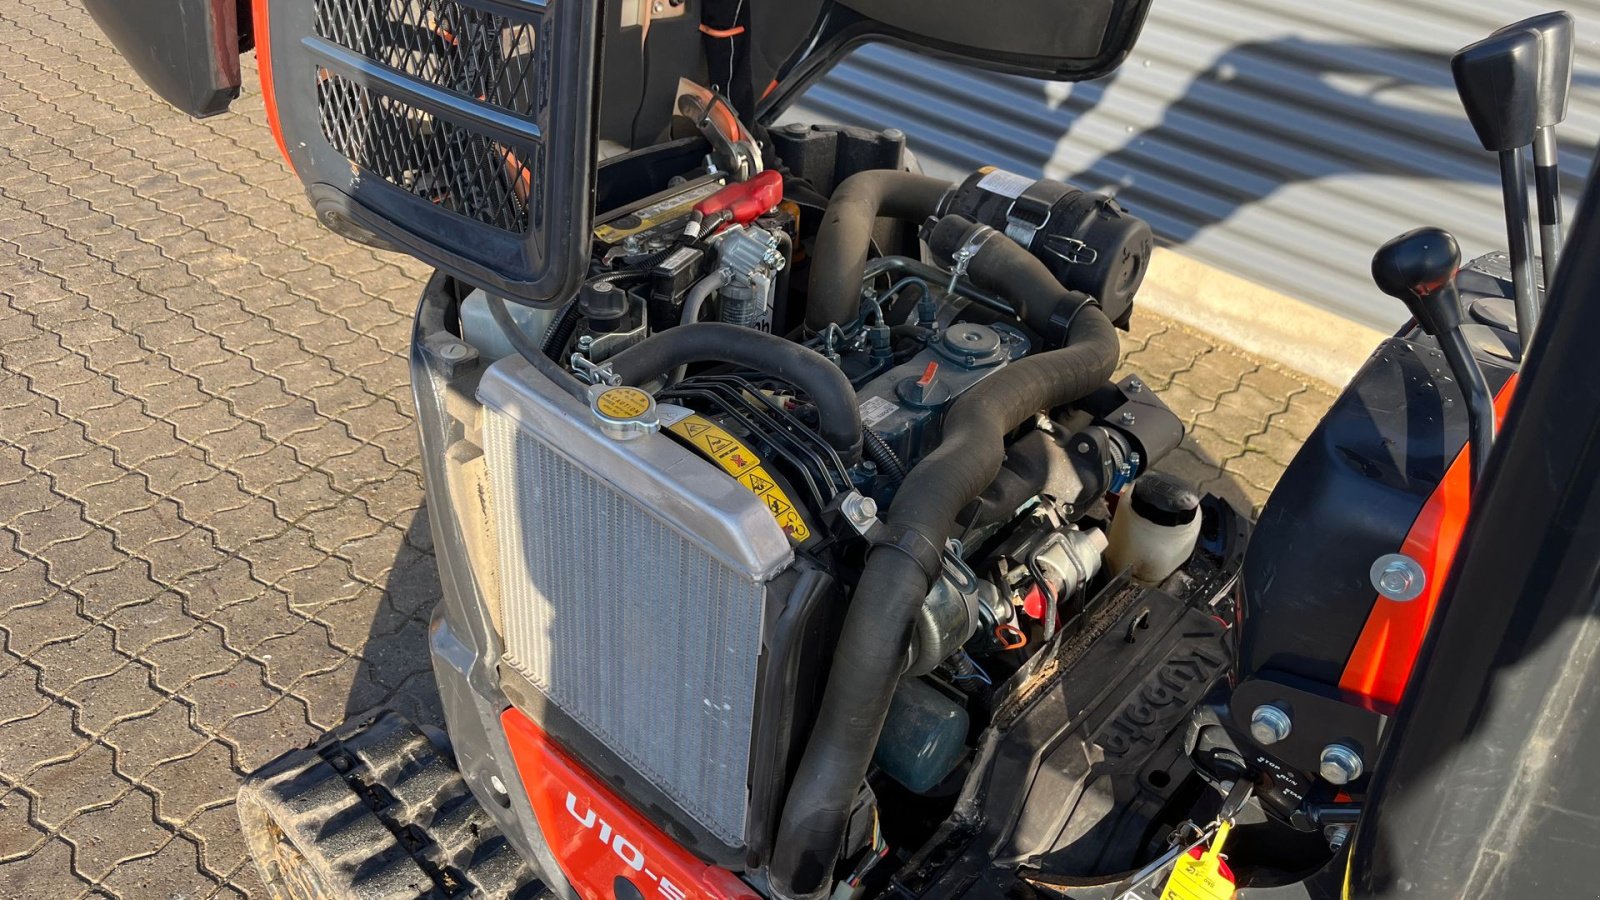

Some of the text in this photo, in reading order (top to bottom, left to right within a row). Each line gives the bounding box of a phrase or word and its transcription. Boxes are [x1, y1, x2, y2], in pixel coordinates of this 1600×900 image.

[1098, 646, 1223, 759] Kubota
[1257, 756, 1281, 770] STOP
[1279, 774, 1298, 786] RUN
